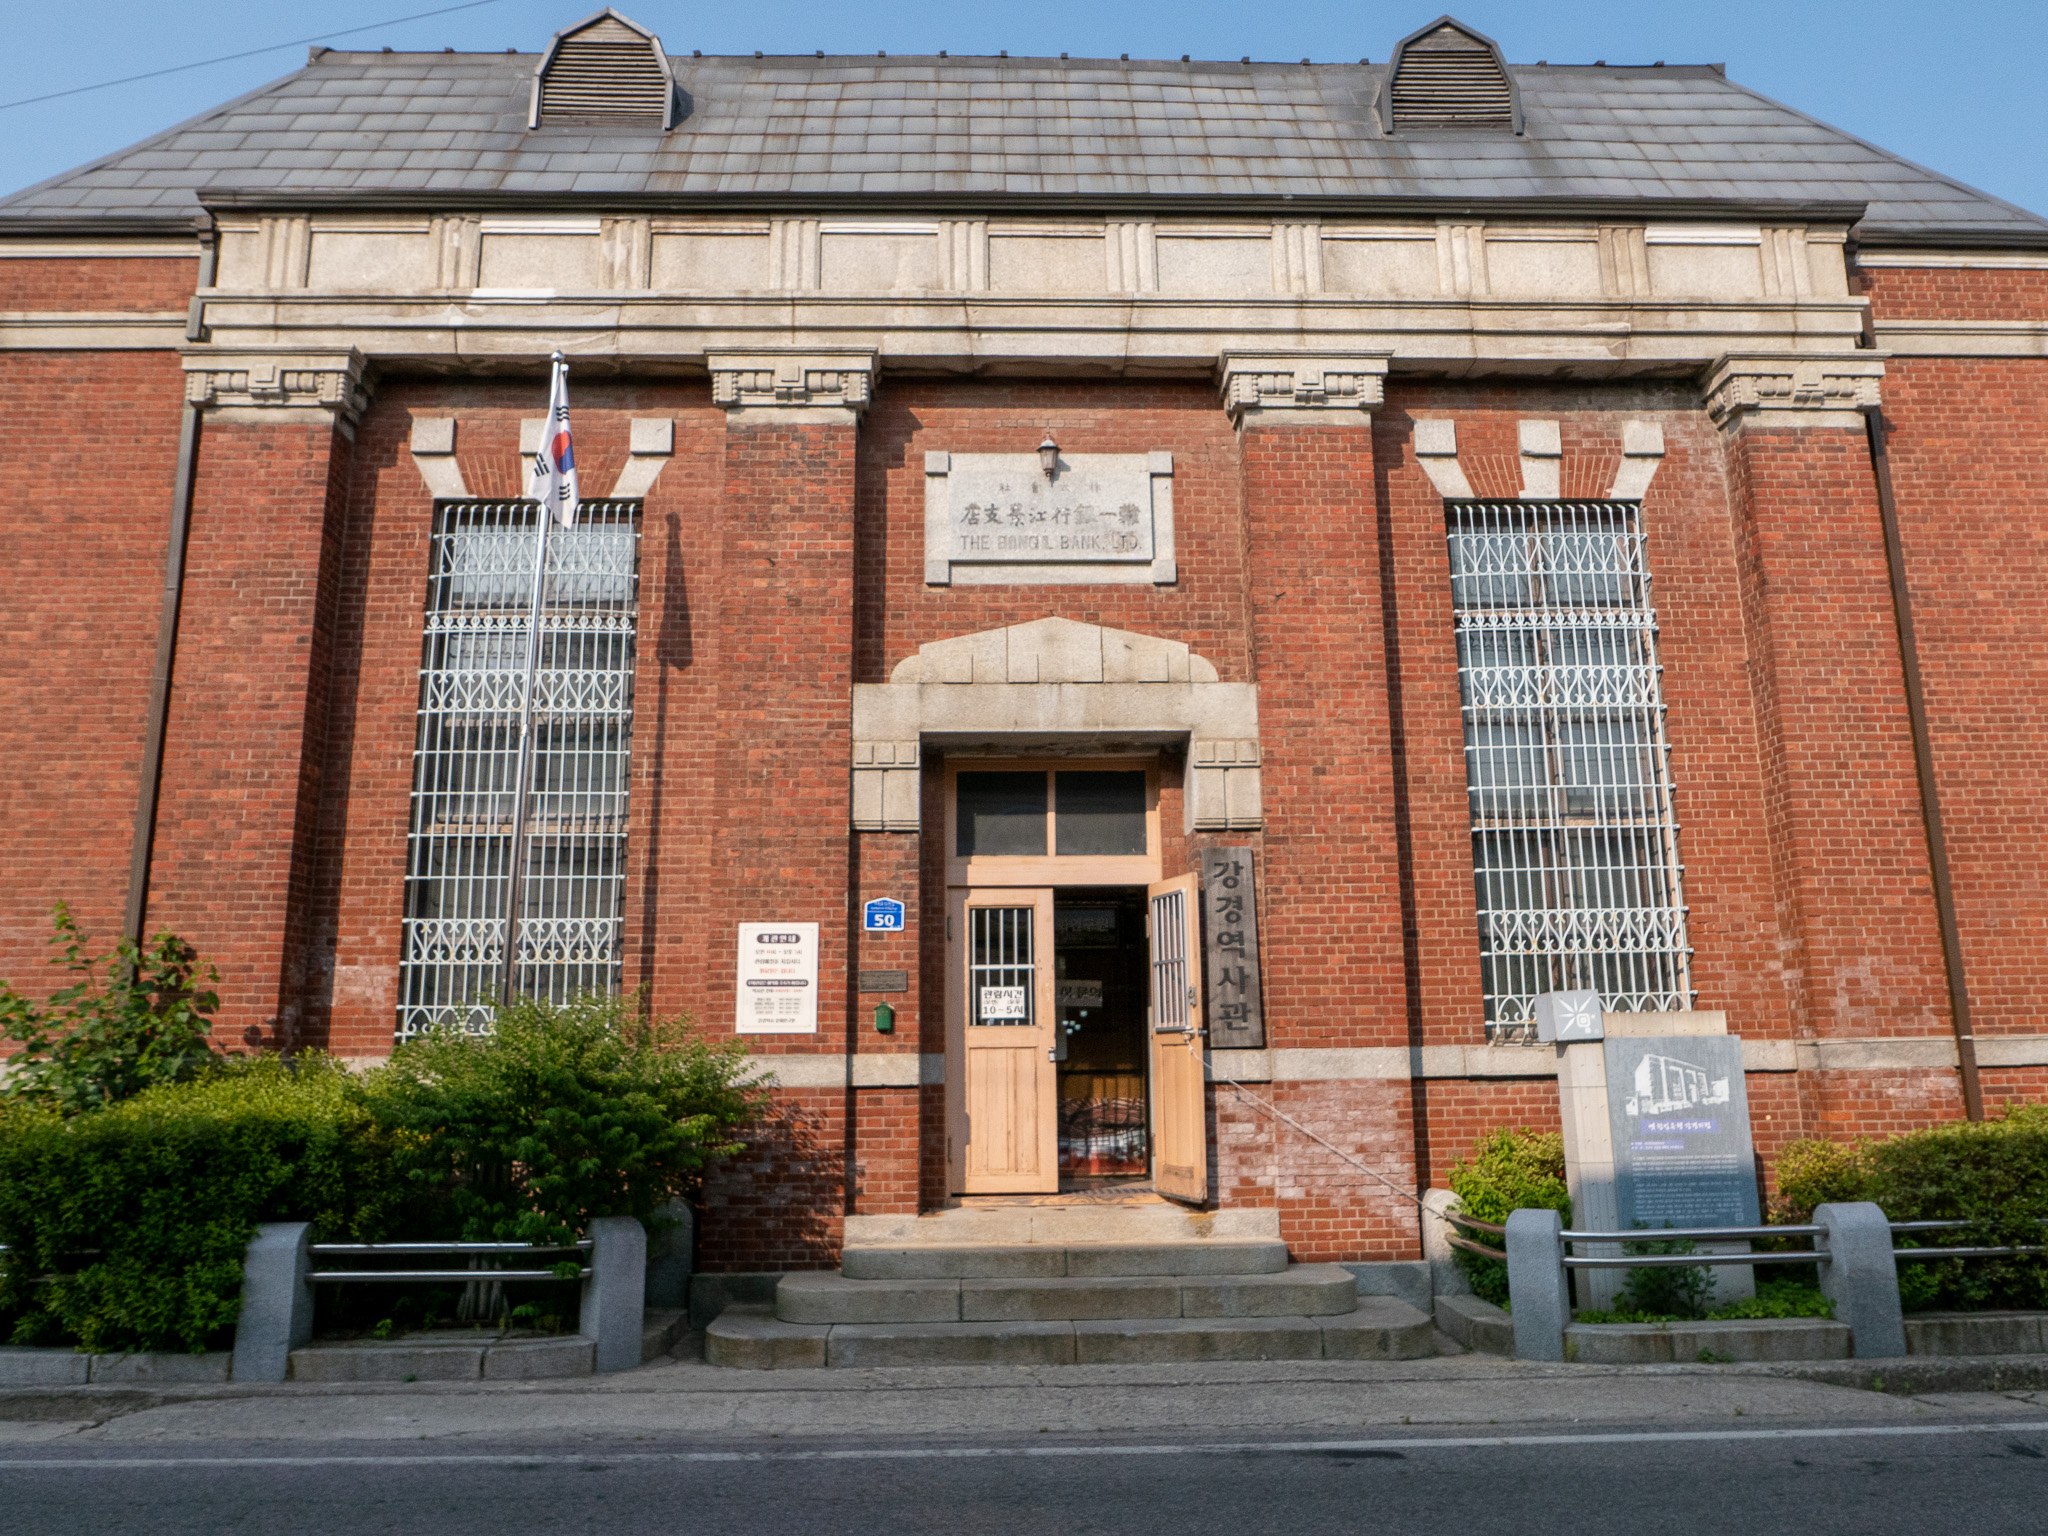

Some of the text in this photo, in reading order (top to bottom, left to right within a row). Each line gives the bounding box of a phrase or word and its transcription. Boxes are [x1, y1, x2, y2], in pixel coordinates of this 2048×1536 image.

[960, 534, 990, 550] THE
[874, 914, 895, 927] 50
[1213, 860, 1252, 1031] 강경역사관
[983, 990, 1023, 999] 관람시간
